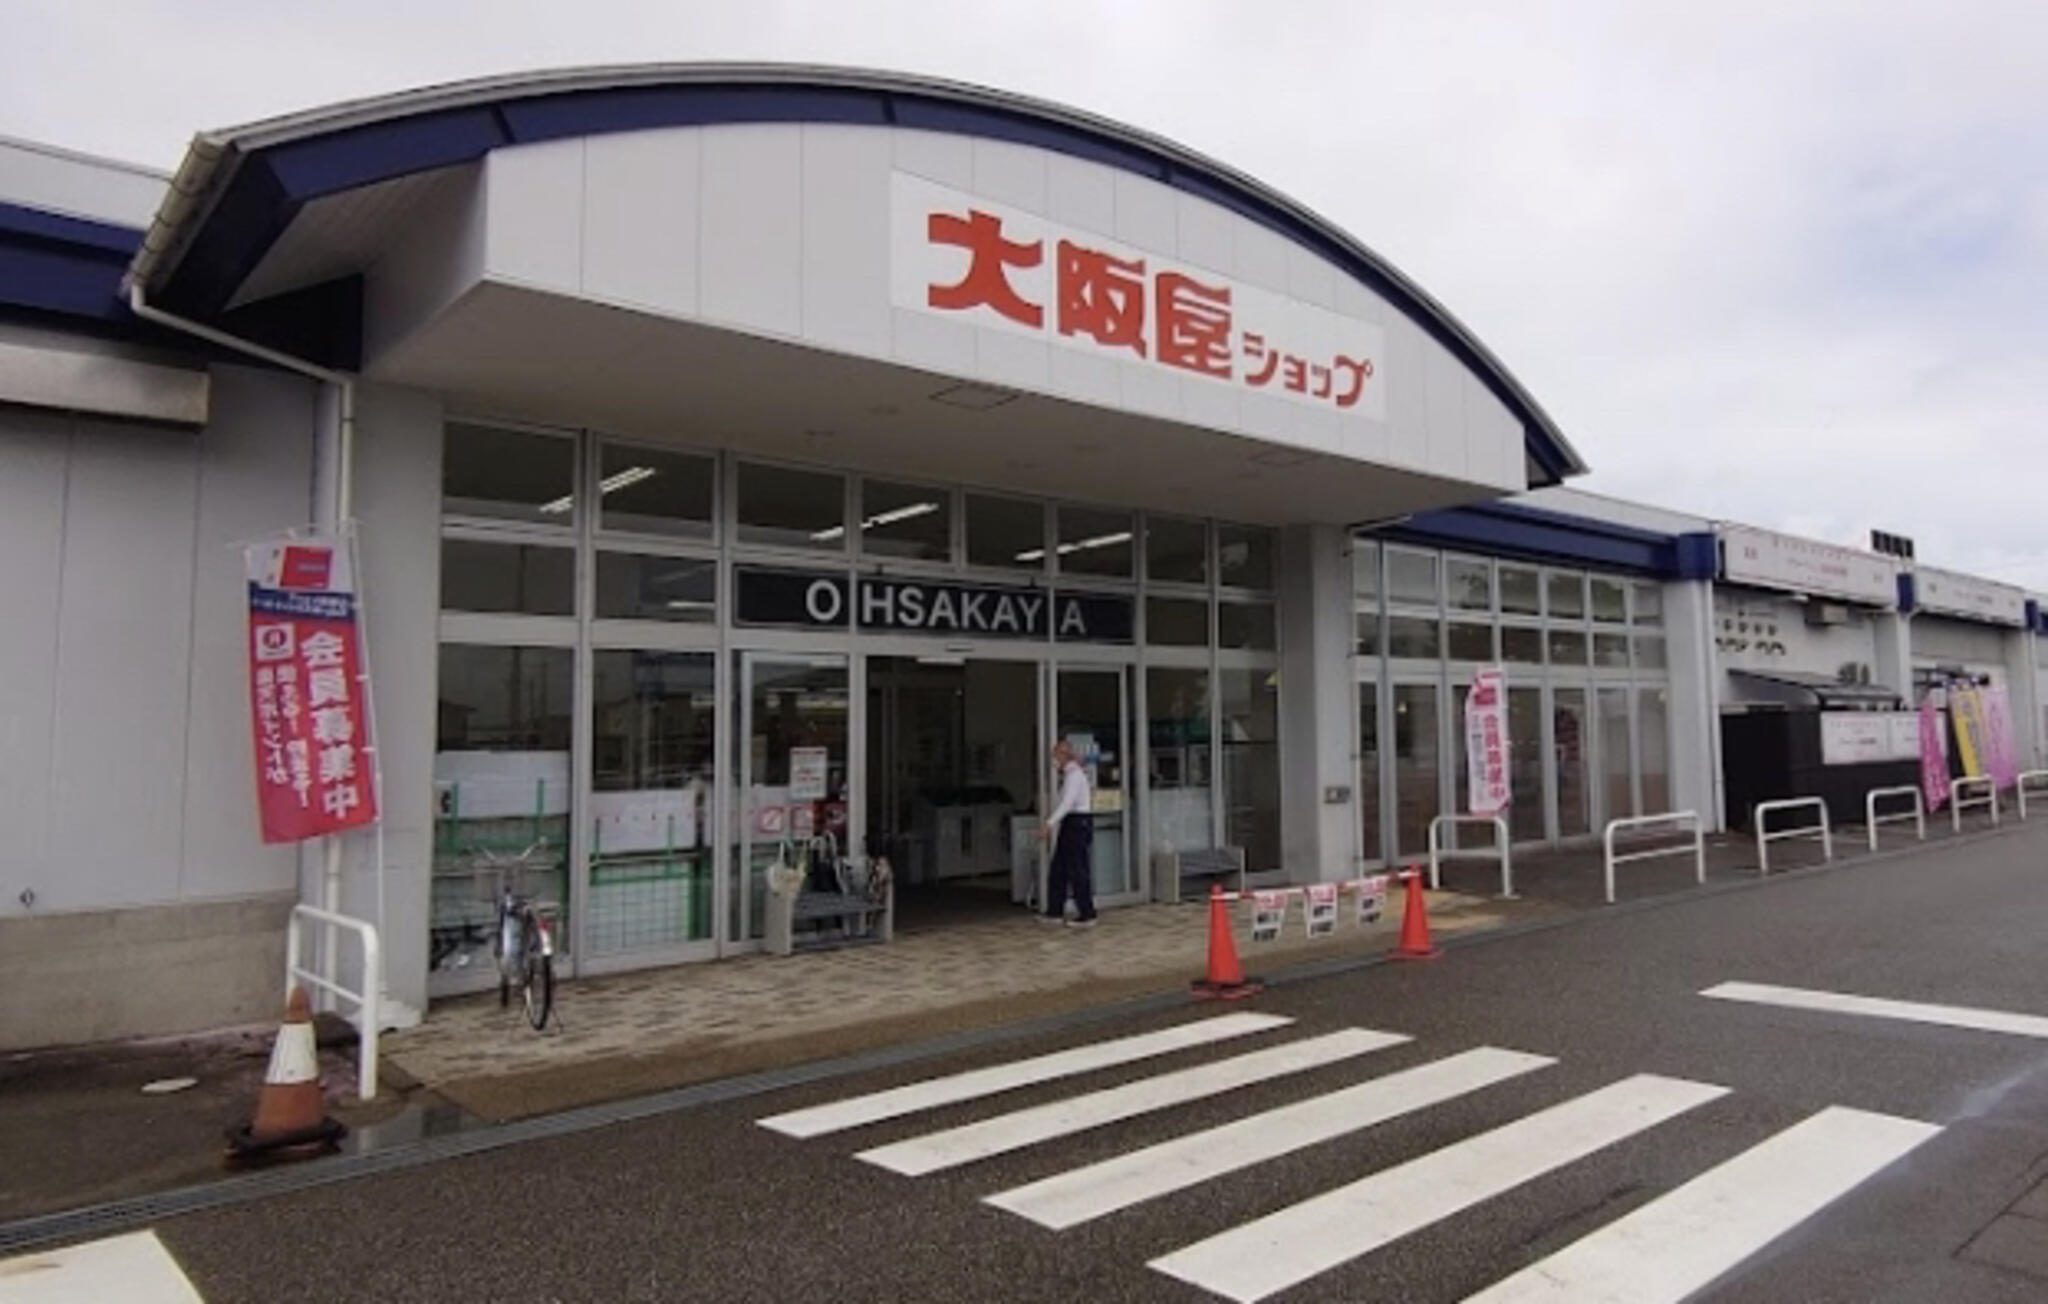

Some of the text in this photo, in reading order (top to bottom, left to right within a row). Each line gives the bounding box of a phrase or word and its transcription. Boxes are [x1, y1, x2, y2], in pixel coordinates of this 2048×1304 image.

[928, 209, 1374, 407] 大阪屋ショップ
[805, 578, 1087, 636] OHSAKAYA
